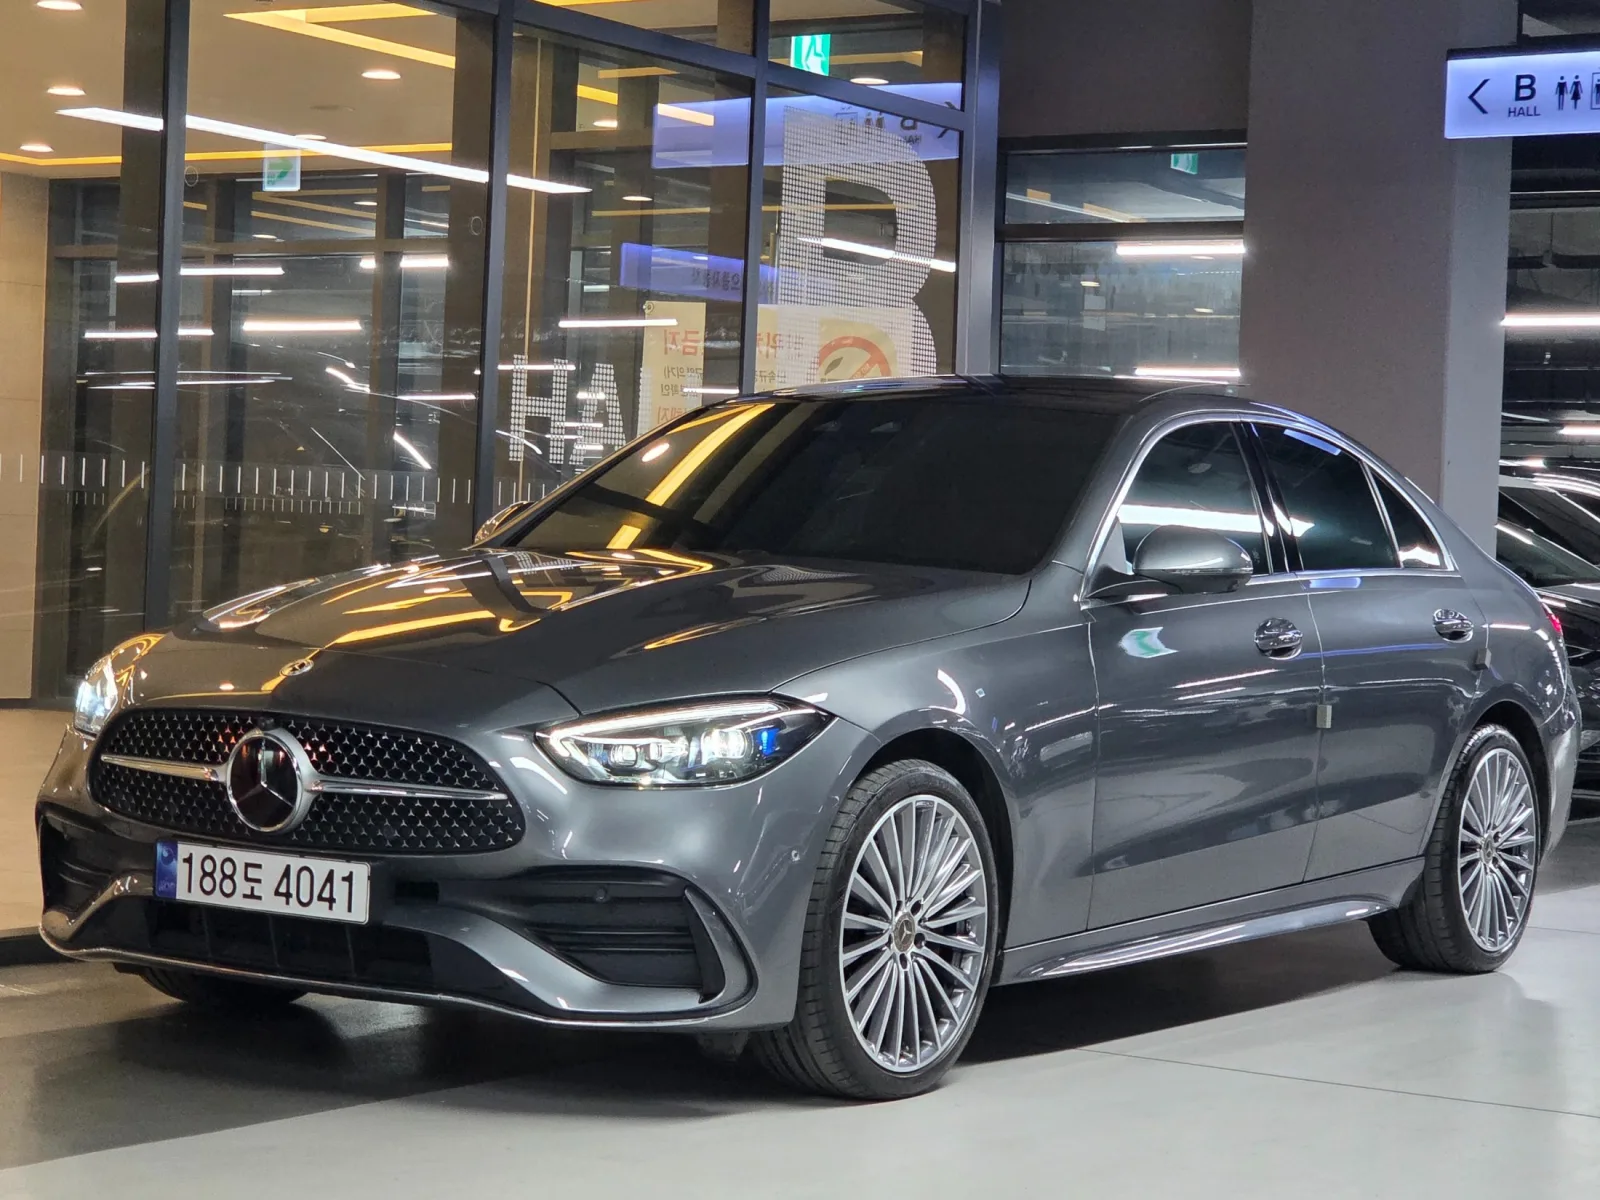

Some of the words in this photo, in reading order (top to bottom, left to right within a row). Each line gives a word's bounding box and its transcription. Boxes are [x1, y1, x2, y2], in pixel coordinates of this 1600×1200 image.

[1507, 106, 1541, 118] HALL
[1515, 74, 1536, 101] B
[779, 105, 937, 377] B
[509, 354, 702, 465] HA
[182, 852, 263, 901] 188도
[274, 863, 354, 913] 4041
